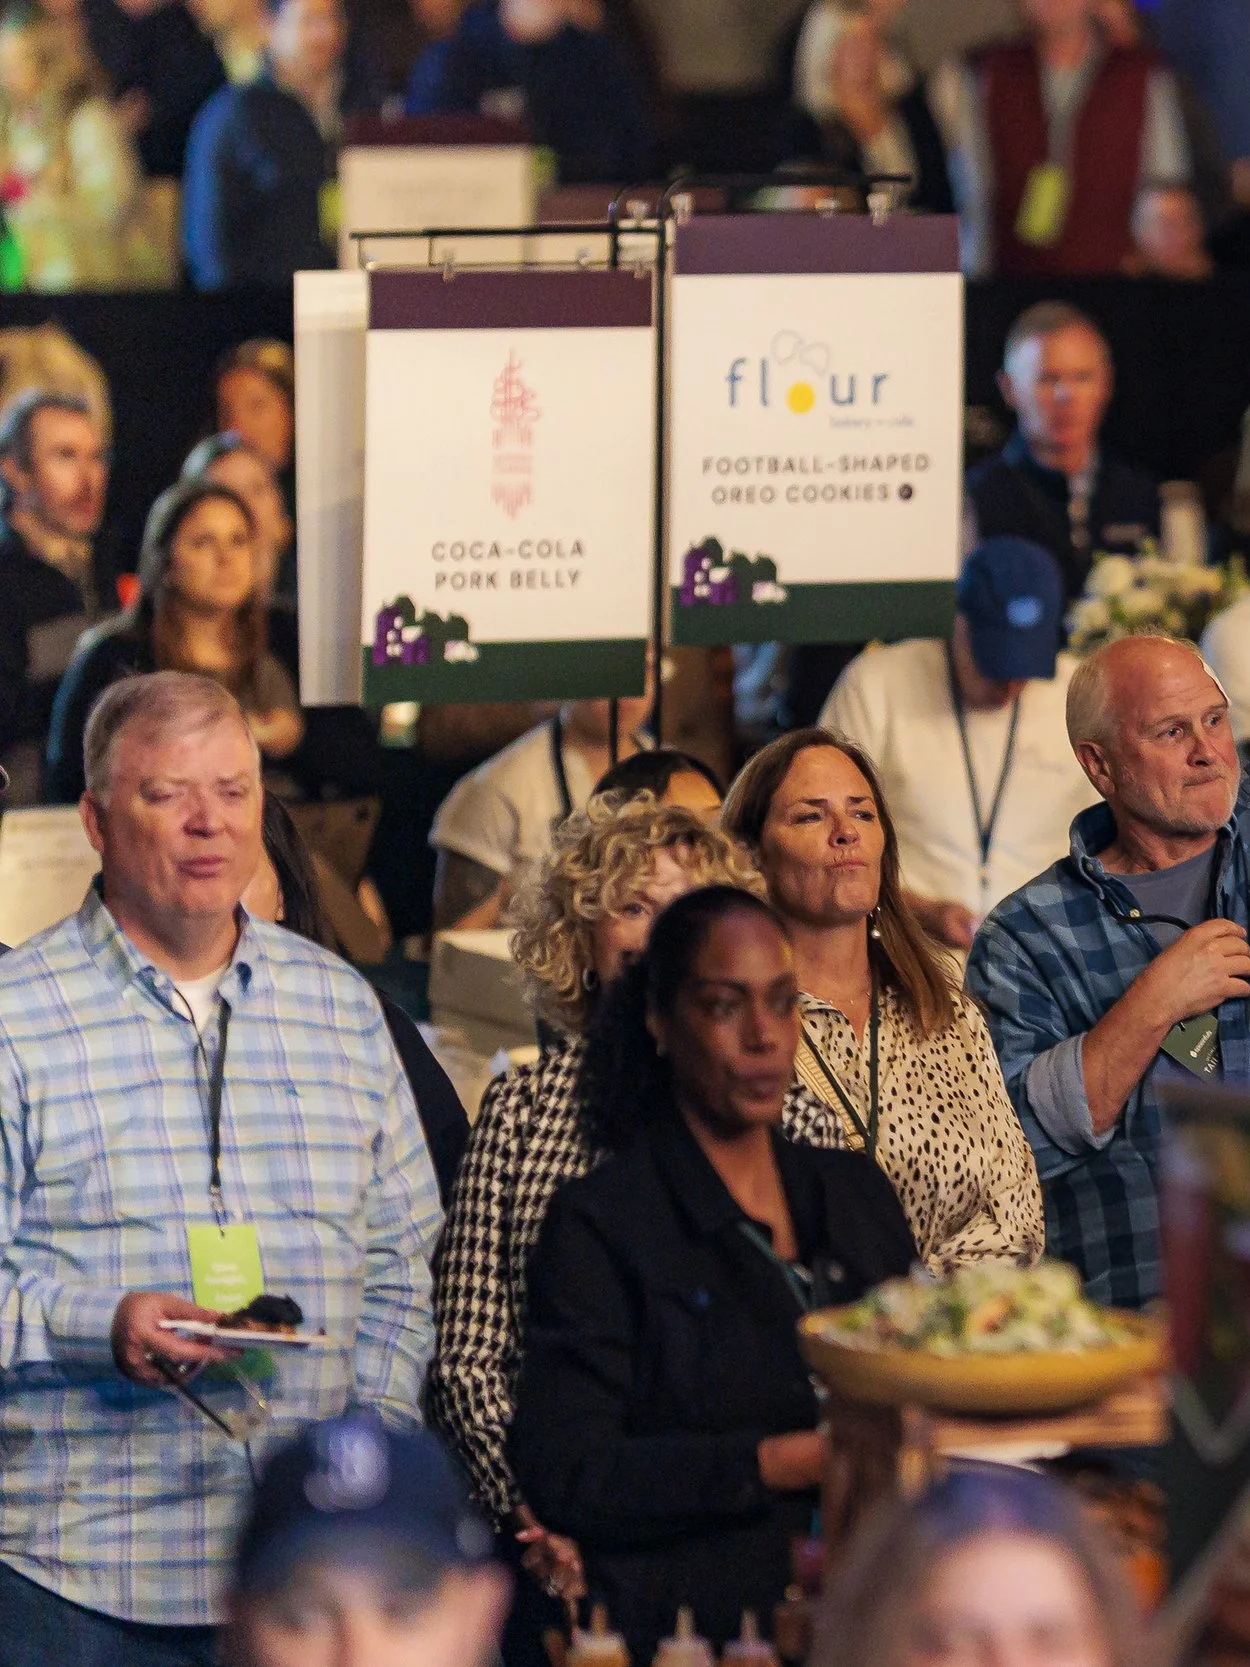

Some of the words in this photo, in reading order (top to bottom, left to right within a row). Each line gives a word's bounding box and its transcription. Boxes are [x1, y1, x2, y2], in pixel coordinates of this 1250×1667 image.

[701, 453, 930, 476] FOOTBALL-SHAPED
[711, 486, 776, 504] OREO
[785, 483, 891, 504] COOKIES
[431, 539, 586, 561] COCA-COLA
[434, 571, 499, 590] PORK
[510, 569, 582, 589] BELLY
